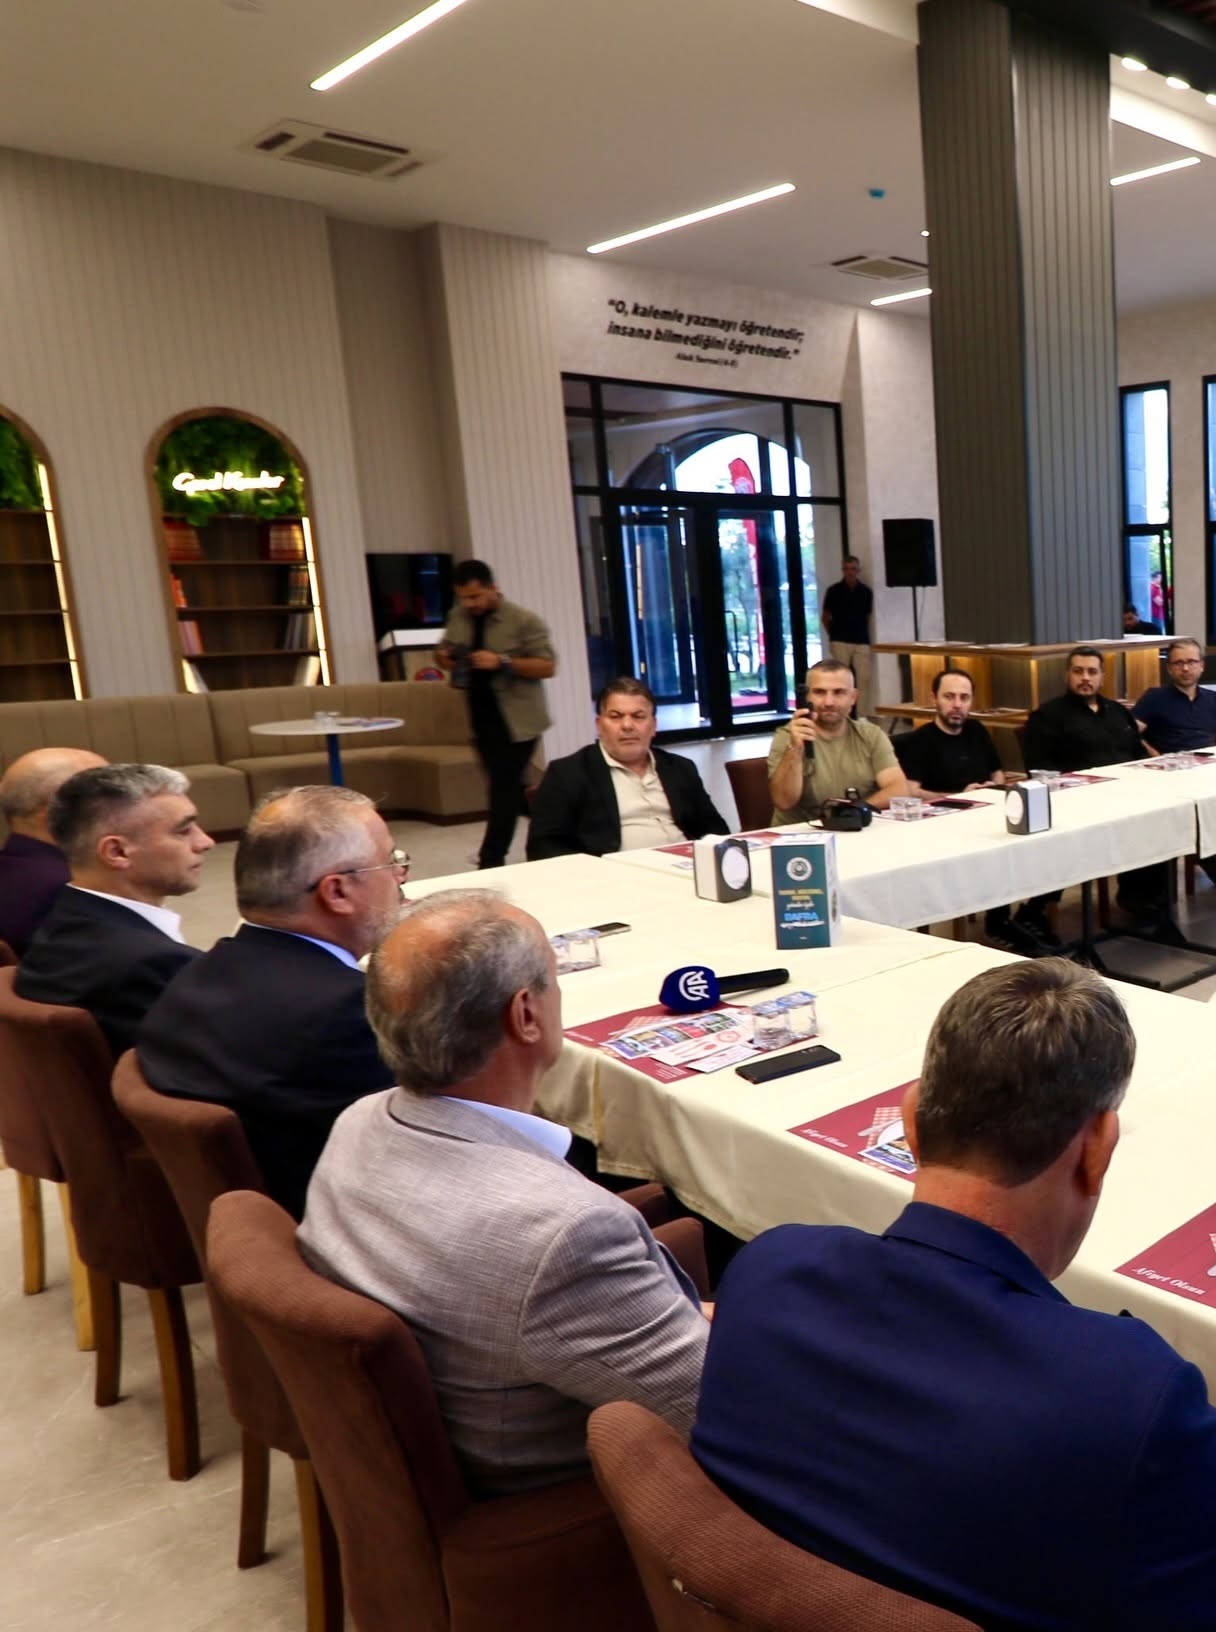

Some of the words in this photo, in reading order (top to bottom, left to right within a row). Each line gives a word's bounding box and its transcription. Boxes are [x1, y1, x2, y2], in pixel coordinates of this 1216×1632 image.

[632, 303, 684, 323] kalemle
[685, 313, 737, 331] yazmayı
[607, 321, 652, 340] insana
[654, 327, 727, 351] bilmediğini
